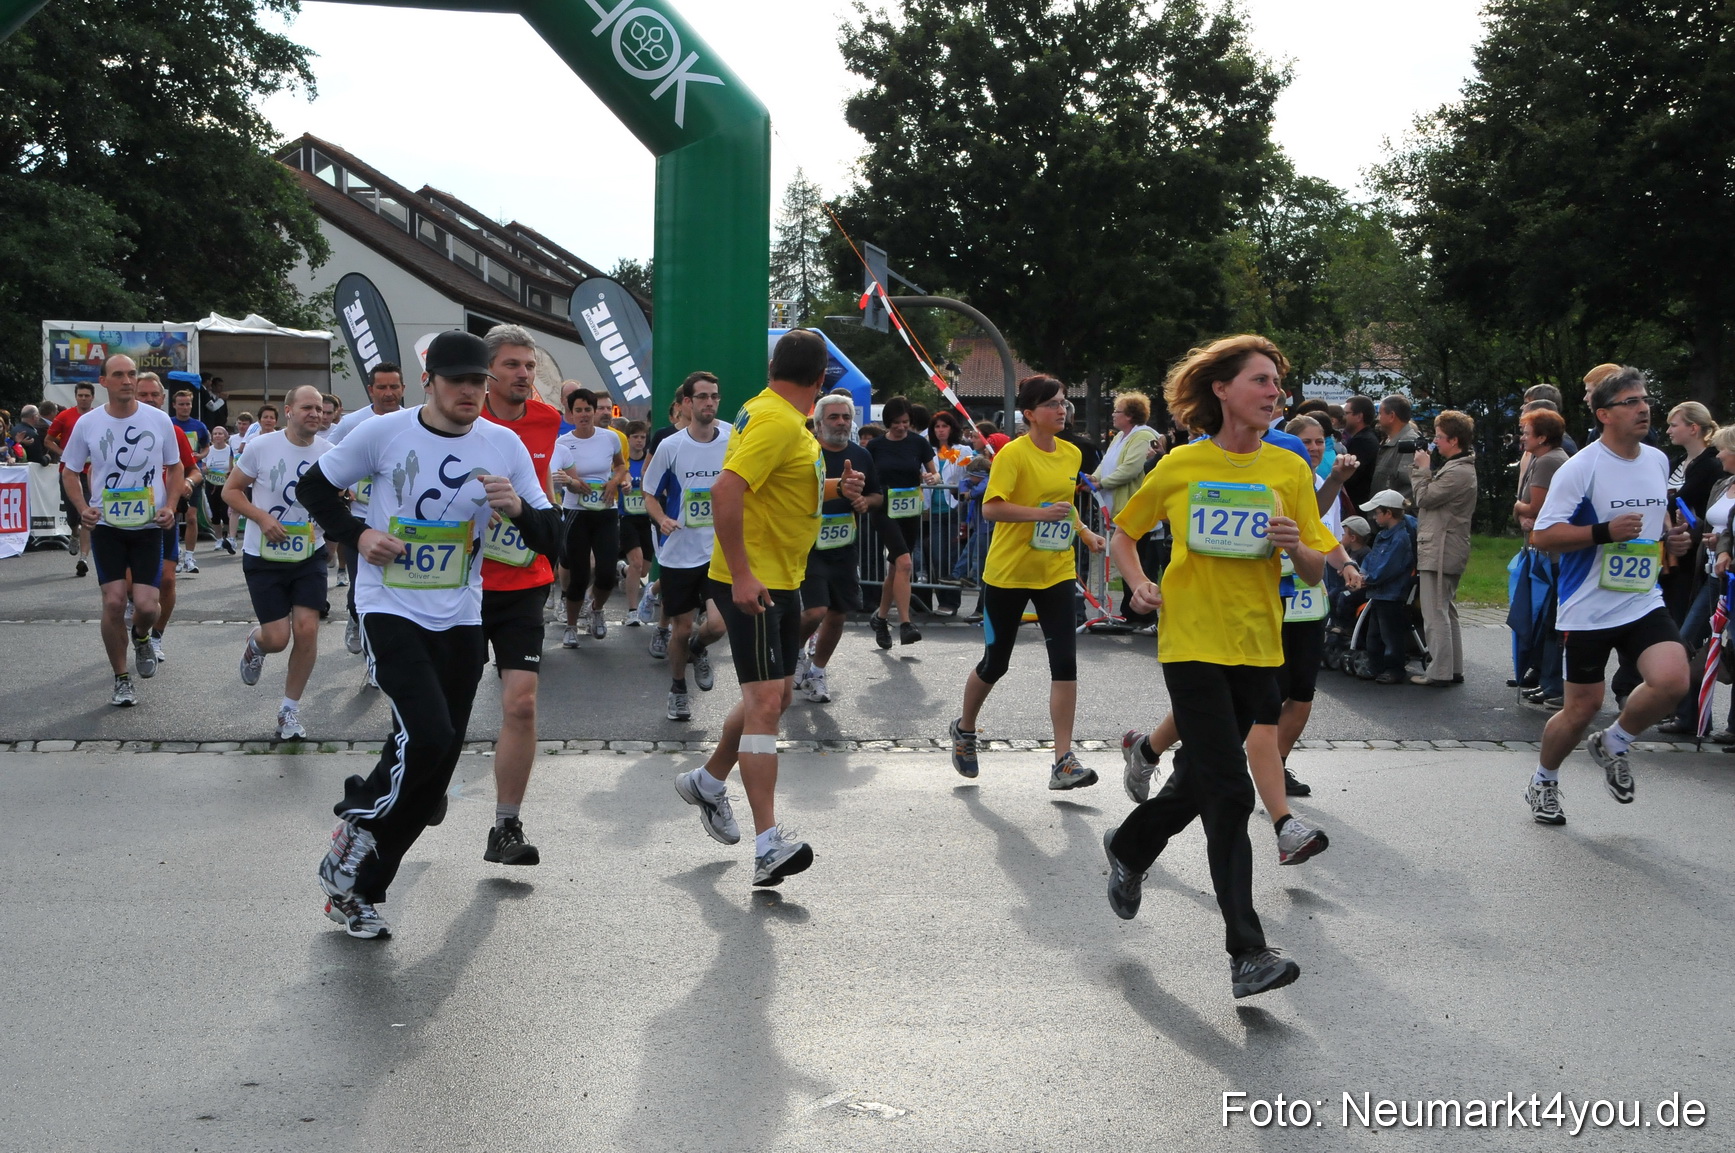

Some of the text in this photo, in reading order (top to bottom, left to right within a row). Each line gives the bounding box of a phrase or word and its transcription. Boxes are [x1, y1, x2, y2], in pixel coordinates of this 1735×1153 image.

[55, 344, 106, 360] TLA
[133, 352, 174, 368] gistics
[685, 470, 722, 478] DELP
[0, 488, 22, 529] ER
[109, 500, 146, 517] 474
[625, 497, 644, 507] 117
[690, 501, 713, 517] 93
[891, 498, 916, 511] 551
[1610, 498, 1668, 509] DELPH
[1035, 520, 1071, 540] 1279
[1192, 507, 1269, 539] 1278
[820, 525, 849, 541] 556
[266, 536, 304, 552] 466
[1205, 537, 1232, 546] Renate
[393, 542, 457, 573] 467
[1608, 555, 1652, 579] 928
[408, 572, 430, 580] Oliver
